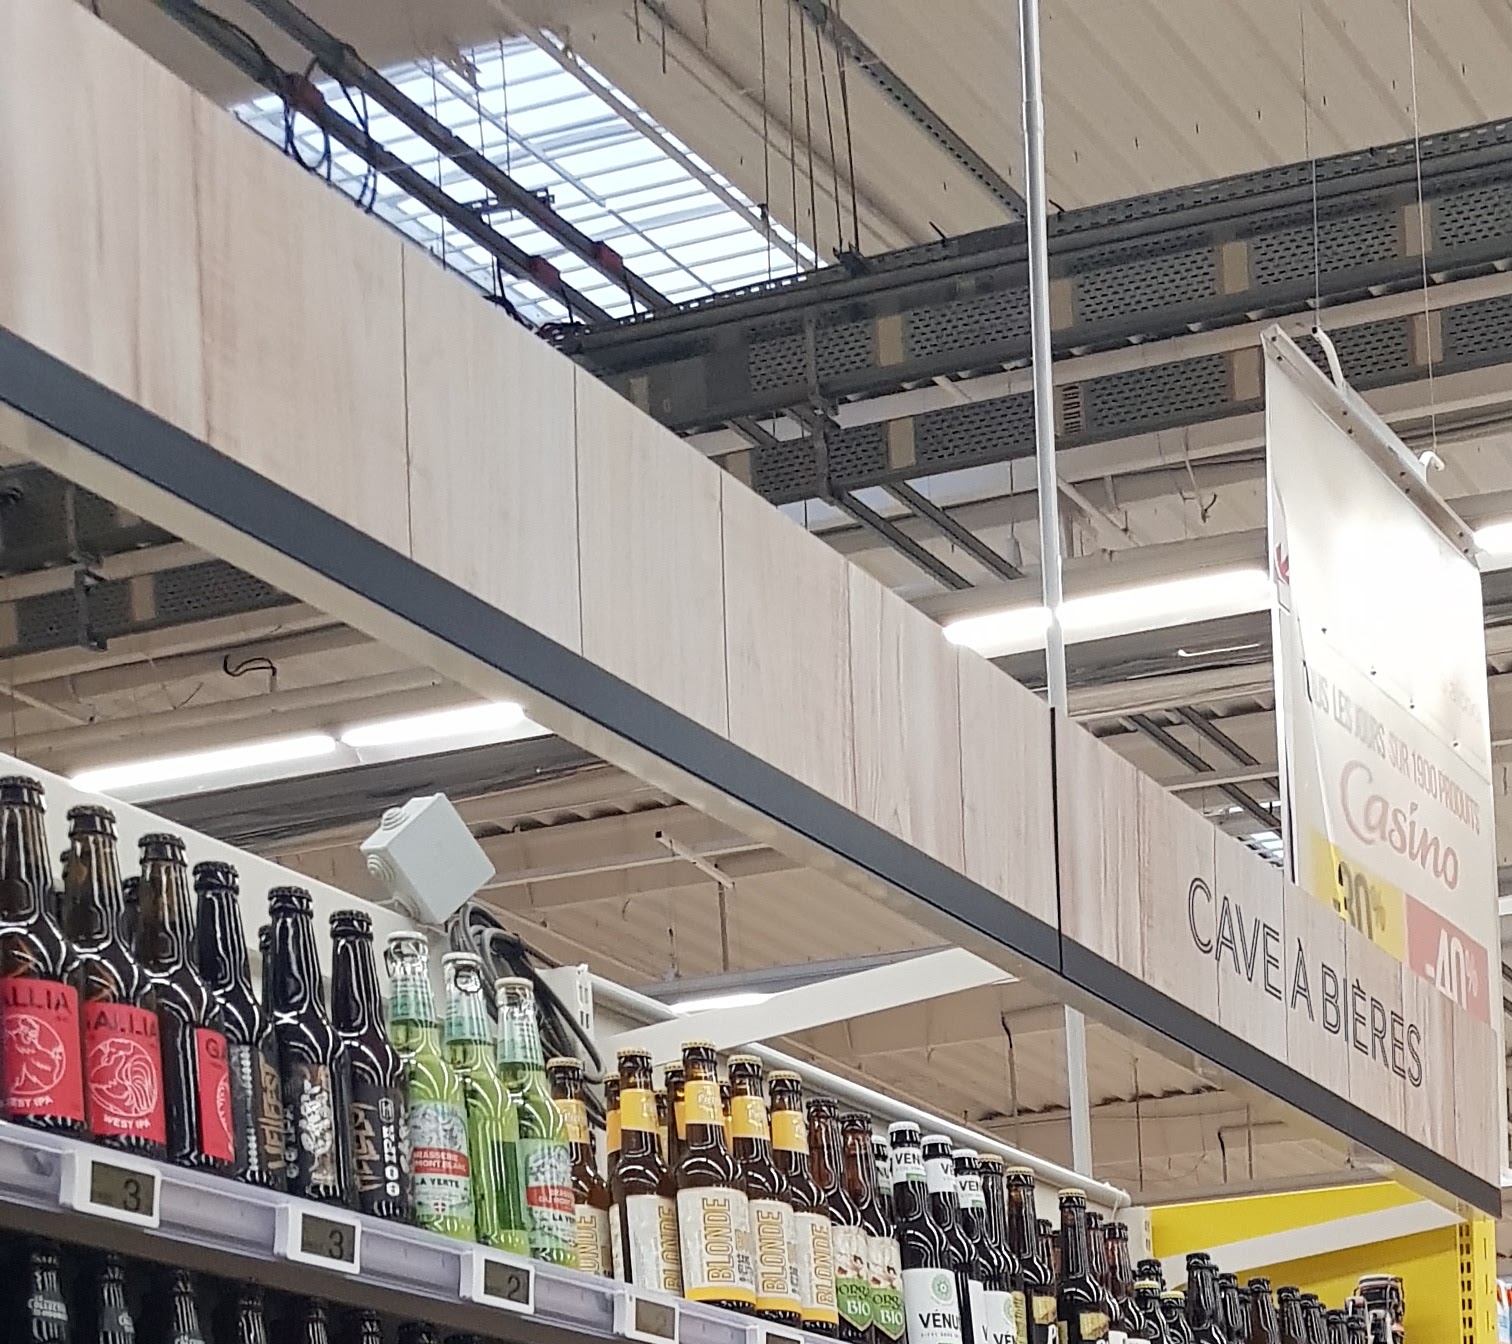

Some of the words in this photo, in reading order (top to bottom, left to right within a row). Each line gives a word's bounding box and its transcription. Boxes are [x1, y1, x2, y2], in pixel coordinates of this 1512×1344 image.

[1339, 759, 1460, 891] Casino
[1188, 877, 1283, 1003] CAVE
[1321, 967, 1423, 1089] BIÈRES
[103, 1115, 133, 1129] WEST
[135, 1118, 150, 1129] IPA
[123, 1178, 141, 1211] 3
[430, 1177, 459, 1189] VERTE
[328, 1230, 343, 1260] 3
[658, 1205, 680, 1292] BLONDE
[701, 1197, 735, 1283] BLONDE
[757, 1209, 788, 1295] BLONDE
[811, 1223, 833, 1306] BLONDE
[507, 1276, 521, 1300] 2
[847, 1300, 870, 1315] BIO
[880, 1310, 902, 1325] BIO
[919, 1309, 961, 1330] VÉNU
